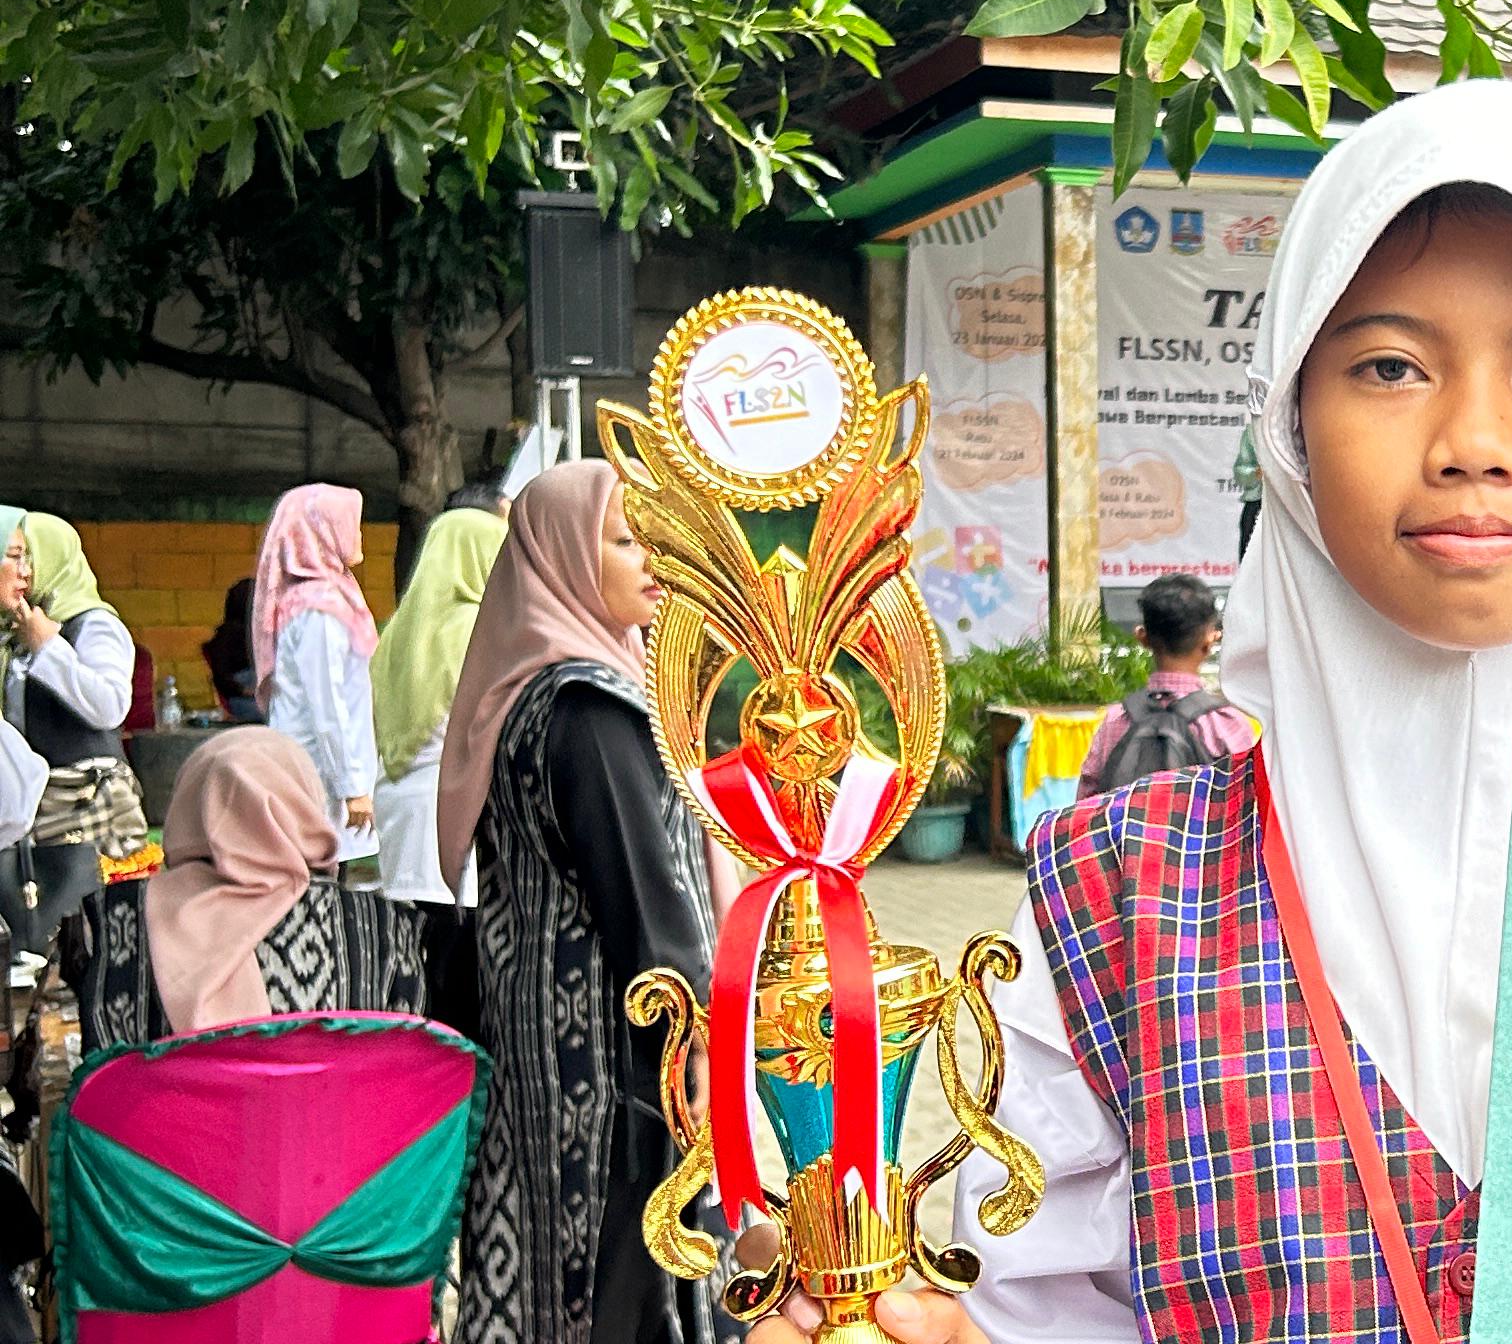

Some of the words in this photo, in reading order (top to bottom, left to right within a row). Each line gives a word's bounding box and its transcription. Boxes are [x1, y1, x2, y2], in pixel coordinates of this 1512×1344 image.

[1118, 336, 1212, 366] FLSSN,
[724, 381, 808, 416] FLS2N
[1126, 386, 1159, 402] dan
[1165, 387, 1219, 404] Lomba
